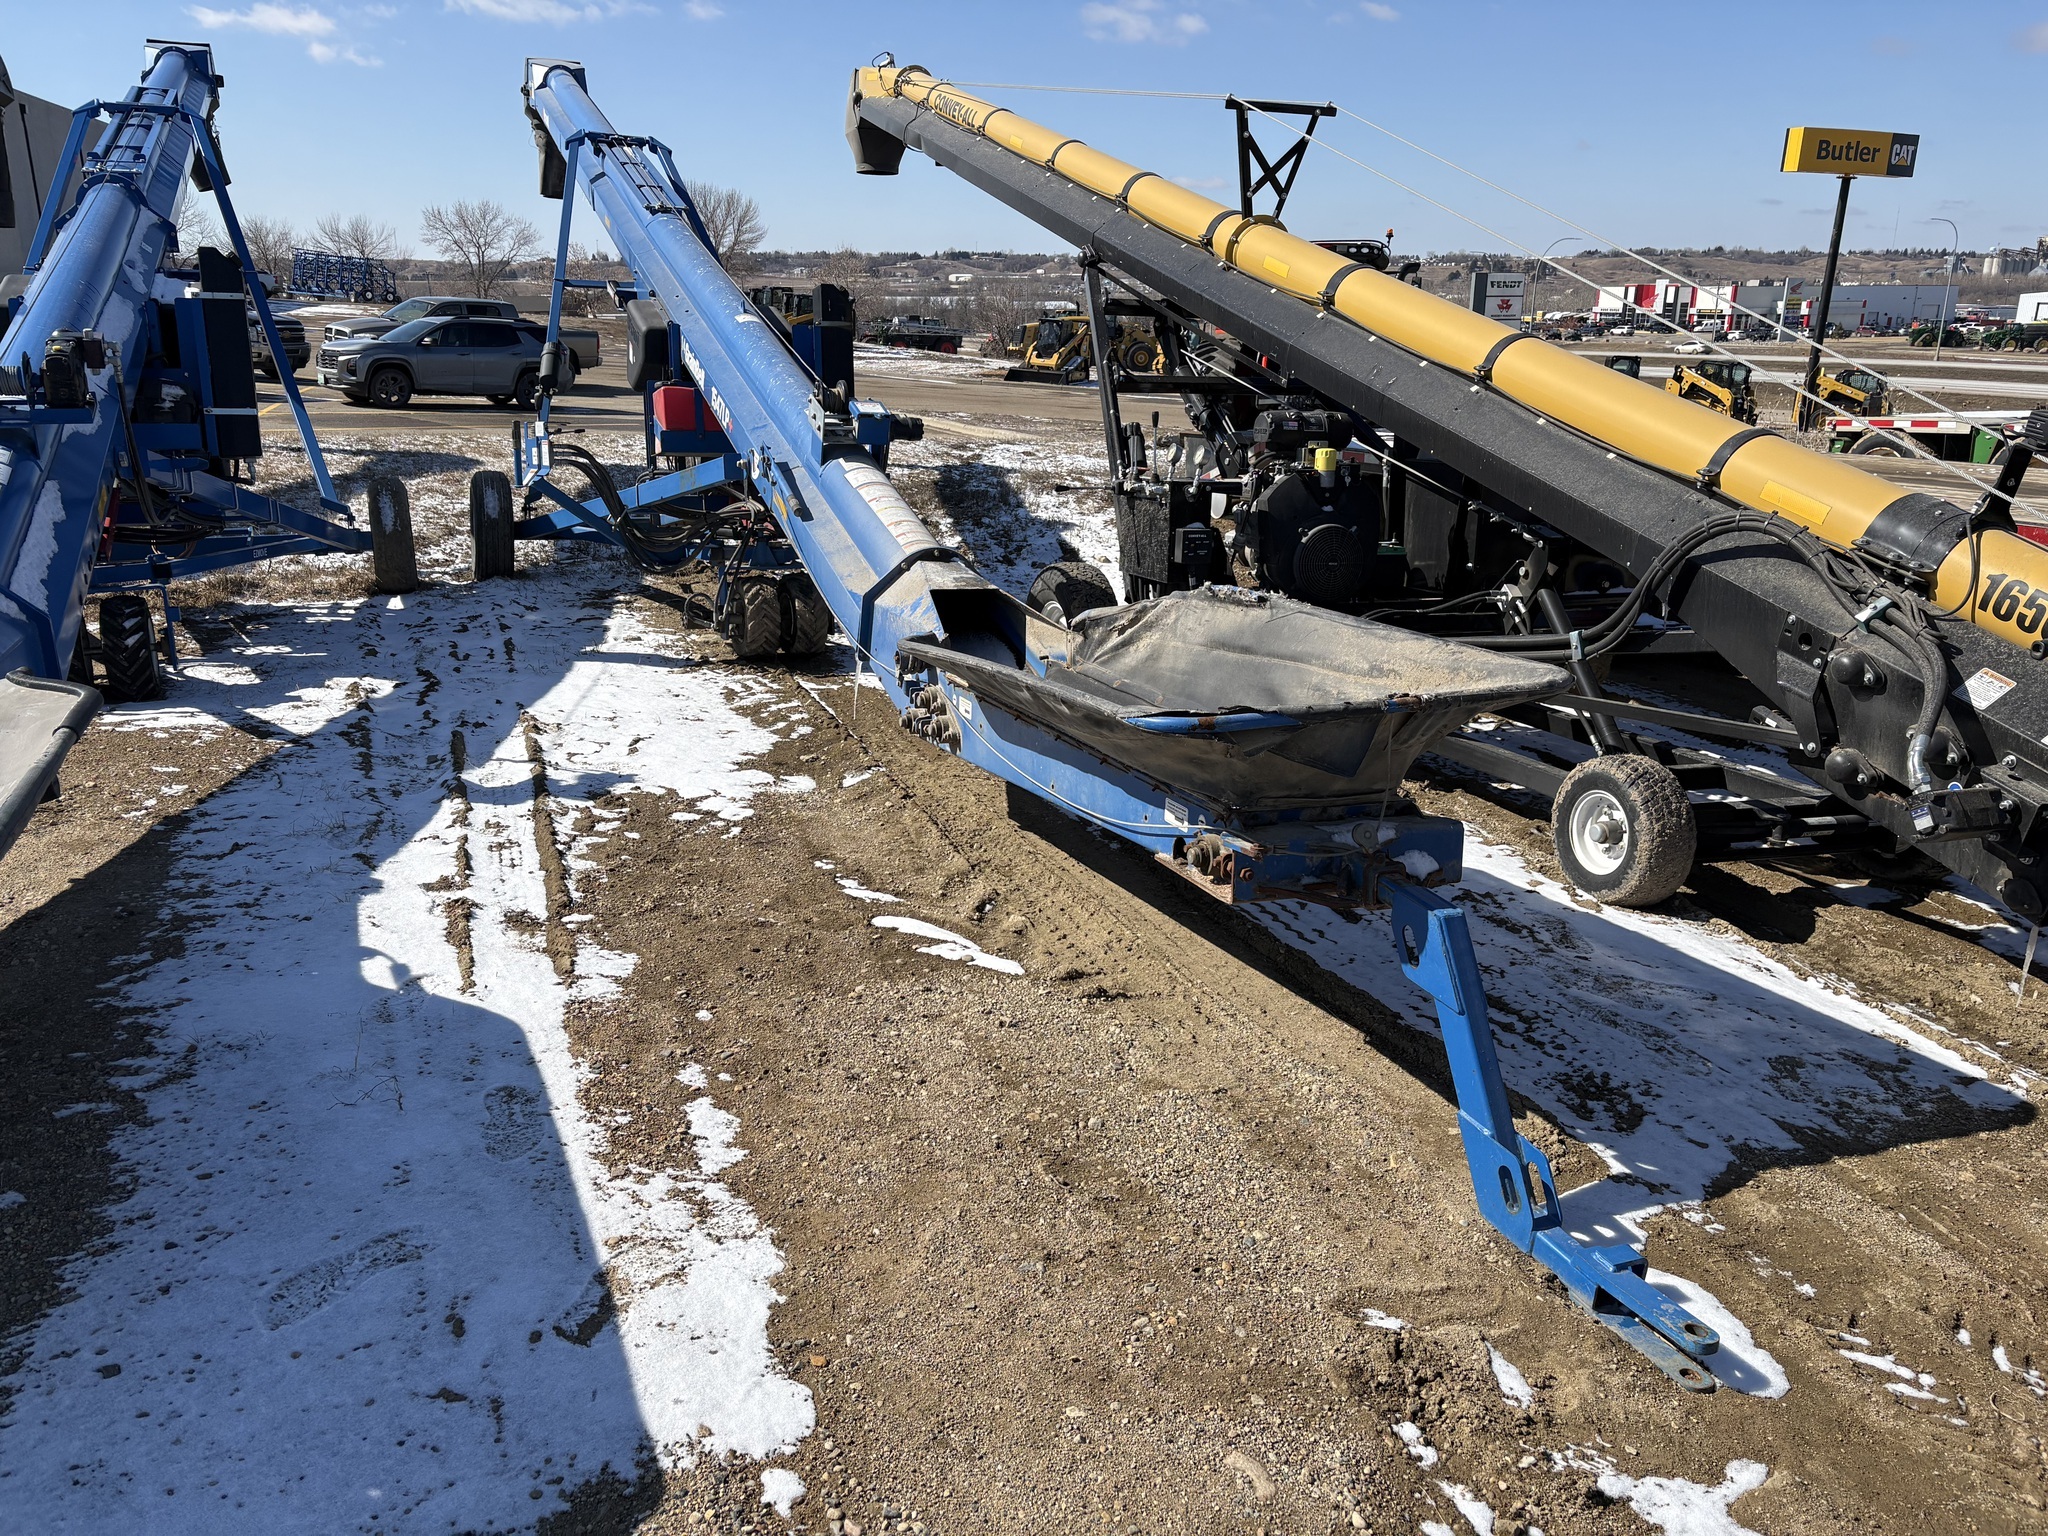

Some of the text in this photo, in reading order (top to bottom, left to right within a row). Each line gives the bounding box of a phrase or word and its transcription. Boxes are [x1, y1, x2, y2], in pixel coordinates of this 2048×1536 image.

[934, 93, 978, 128] CONVEY-ALL
[1816, 139, 1916, 166] Butler CAT
[1490, 280, 1523, 289] FENDT
[1977, 573, 2048, 640] 165
